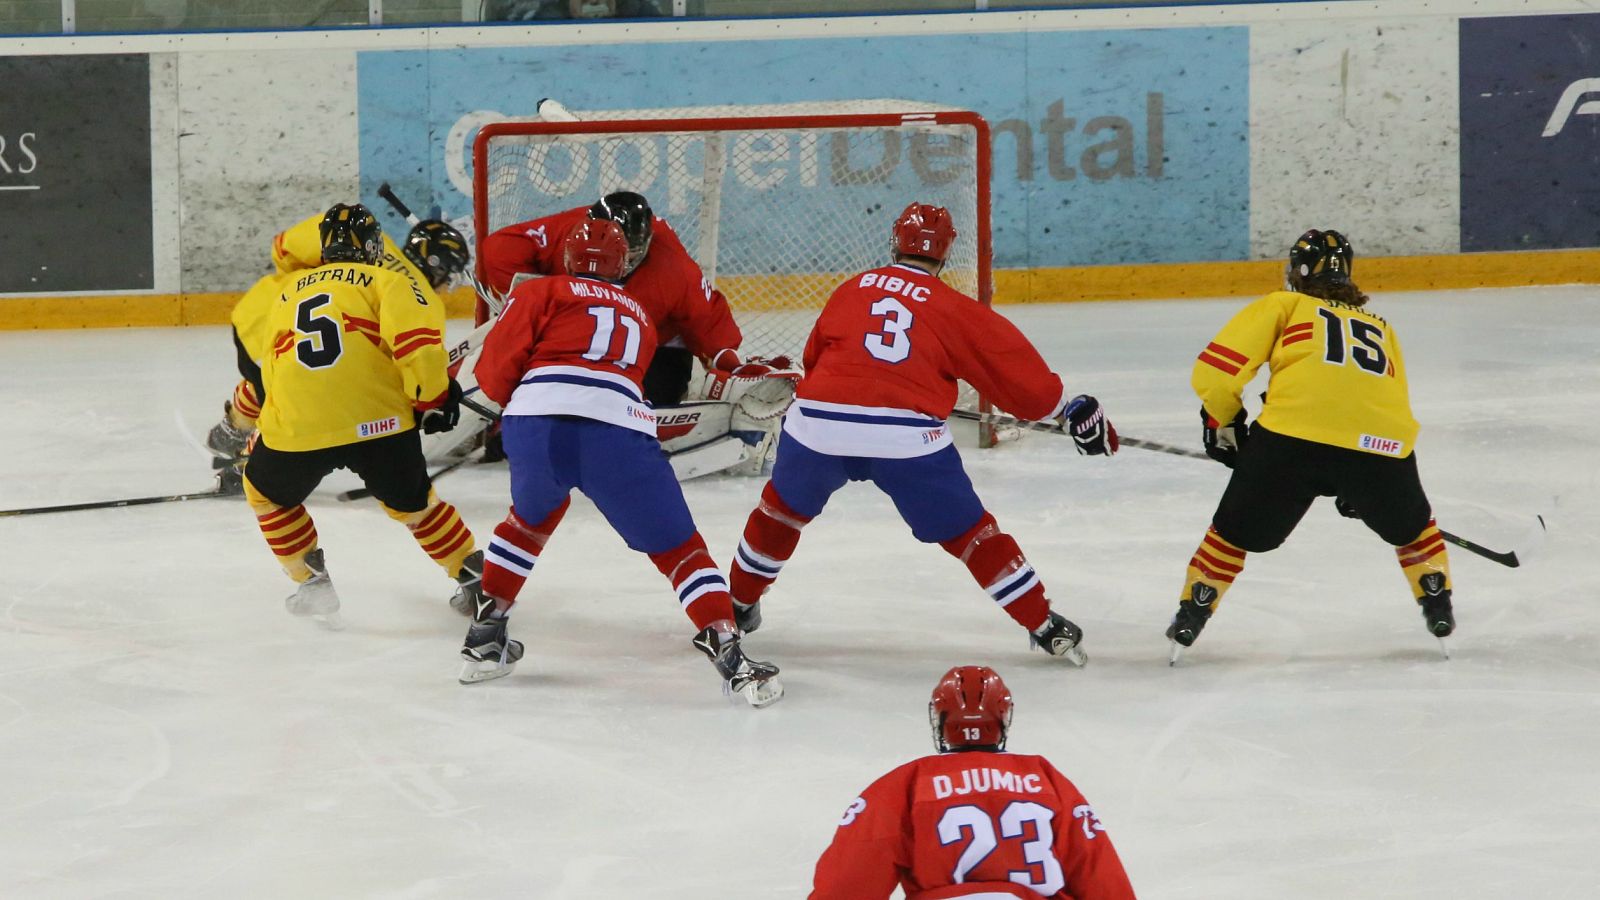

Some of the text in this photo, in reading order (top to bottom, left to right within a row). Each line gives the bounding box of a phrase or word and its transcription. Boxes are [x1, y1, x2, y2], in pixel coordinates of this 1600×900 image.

[922, 239, 931, 251] 3
[296, 267, 374, 293] BETRAN
[859, 273, 932, 303] BIBIC
[294, 292, 343, 370] 5
[581, 305, 641, 371] 11
[864, 296, 914, 365] 3
[1317, 306, 1389, 376] 15
[713, 381, 725, 399] CCM
[369, 418, 396, 434] IIHF
[1371, 438, 1400, 453] IIHF
[962, 727, 980, 740] 13
[933, 767, 1042, 799] DJUMIC
[937, 800, 1065, 897] 23
